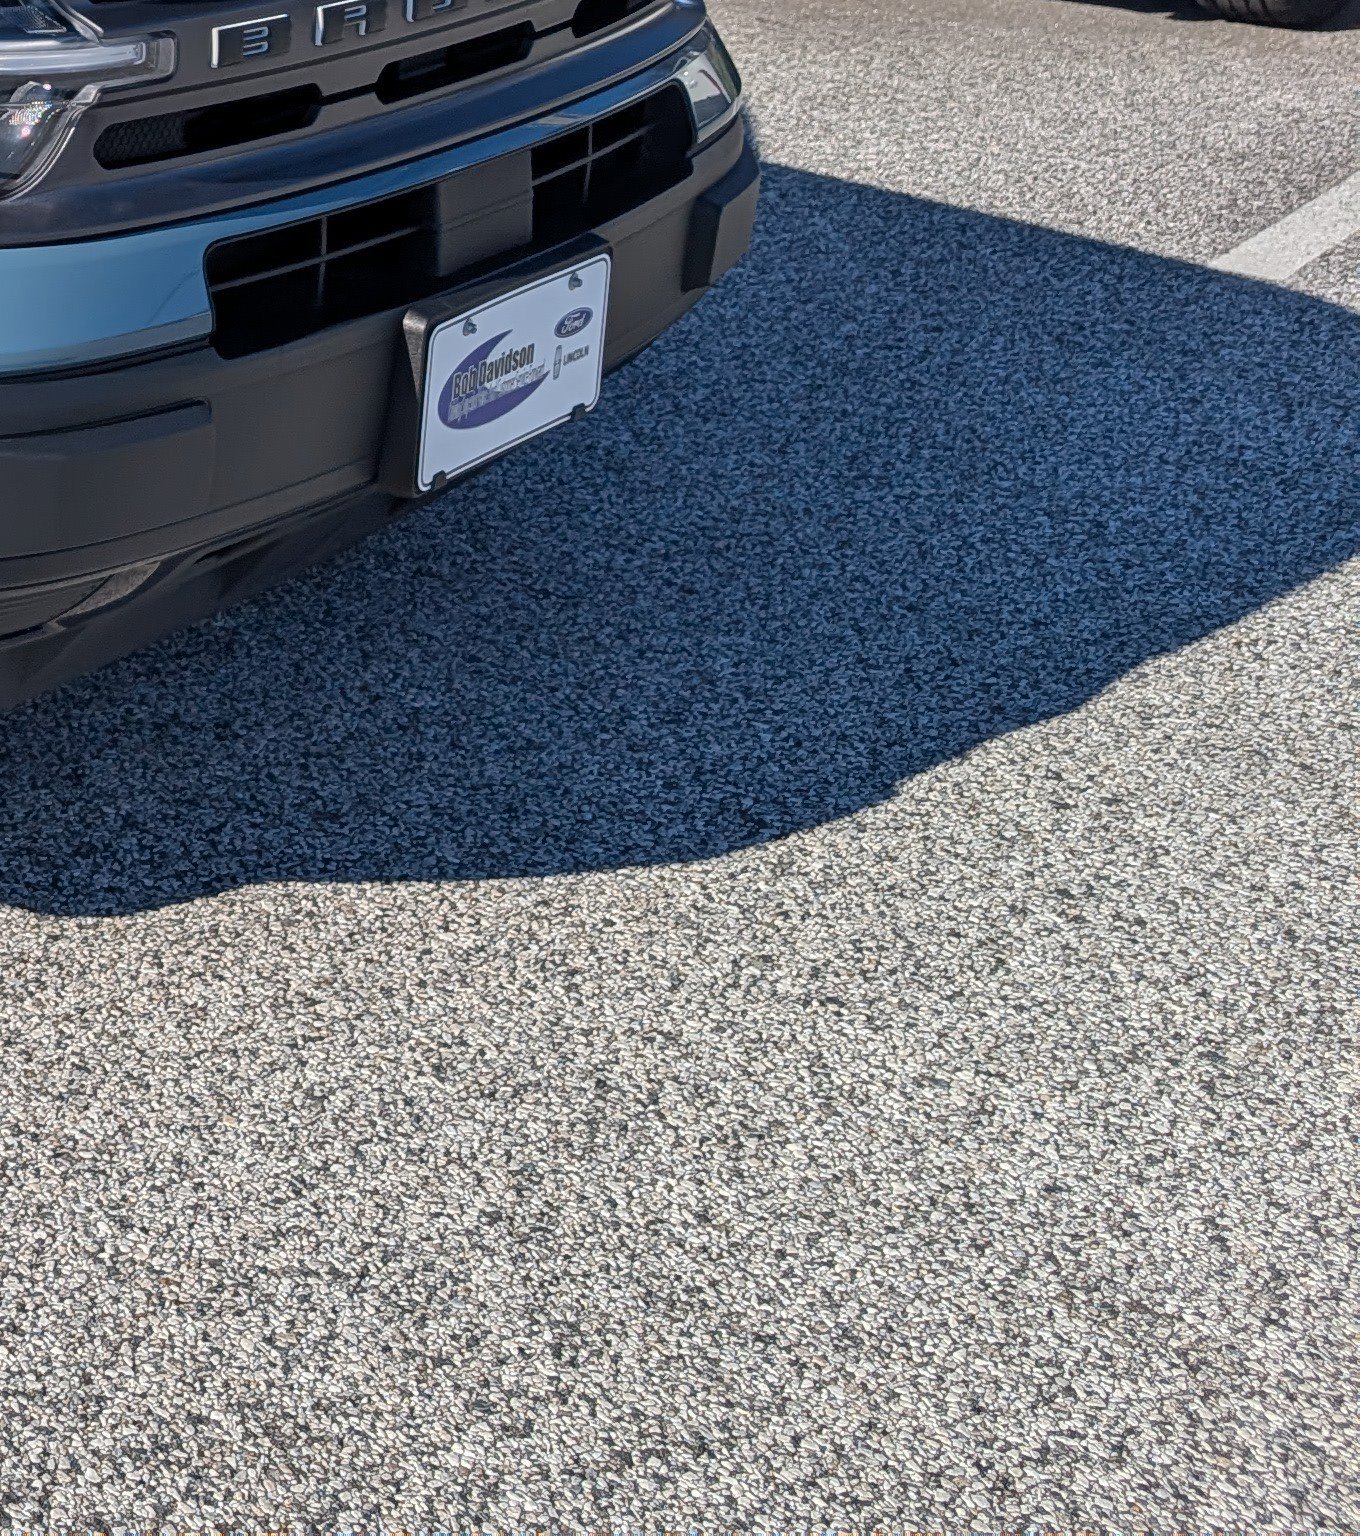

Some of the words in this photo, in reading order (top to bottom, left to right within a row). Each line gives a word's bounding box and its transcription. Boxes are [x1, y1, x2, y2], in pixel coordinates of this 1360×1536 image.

[559, 311, 588, 335] Ford
[452, 364, 479, 398] Bob
[478, 343, 535, 387] Davidson
